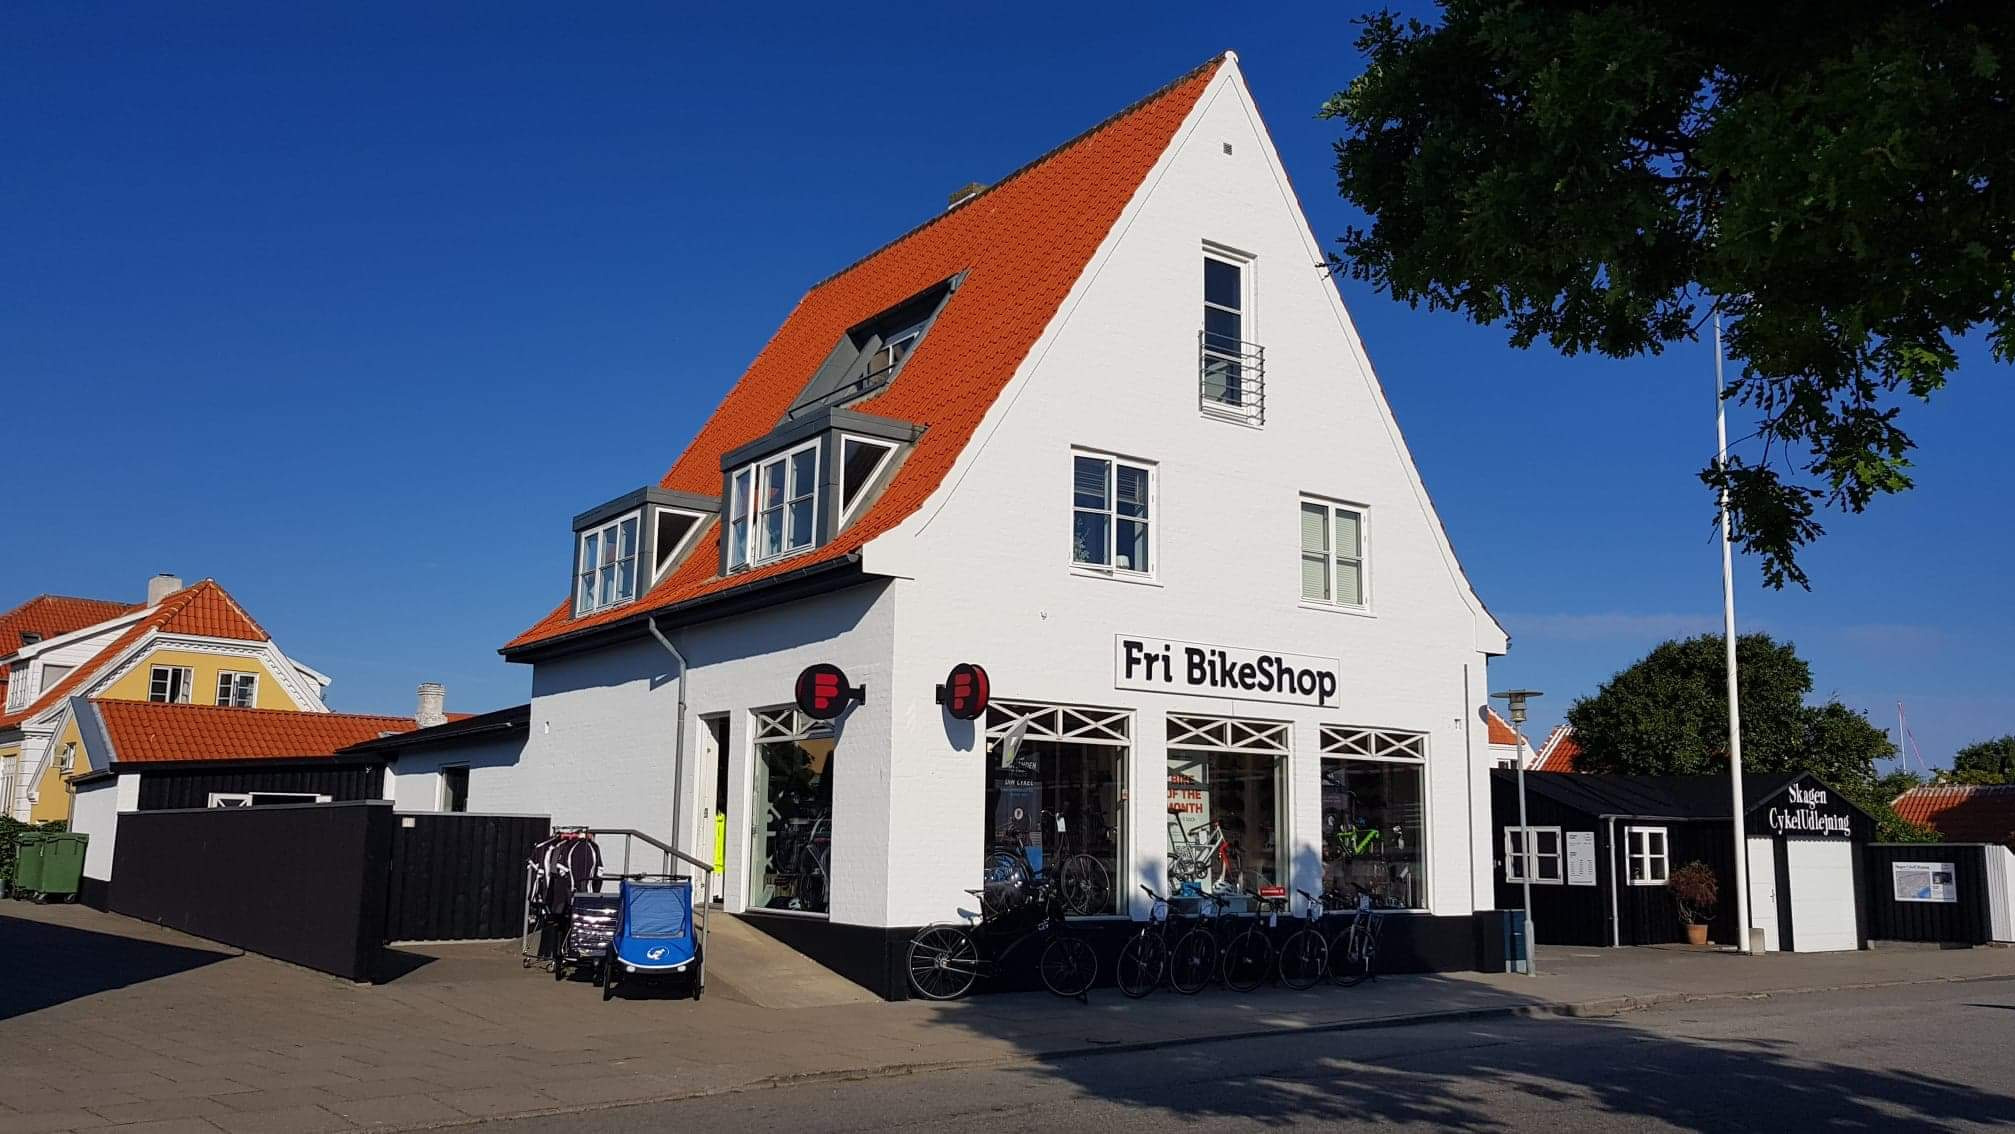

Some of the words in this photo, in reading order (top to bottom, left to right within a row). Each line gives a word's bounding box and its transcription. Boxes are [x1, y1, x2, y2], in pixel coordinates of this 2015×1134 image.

[1123, 639, 1173, 683] Fri
[1184, 646, 1337, 706] BikeShop
[1182, 789, 1202, 800] THE
[1788, 782, 1828, 810] Skagen
[1769, 806, 1851, 837] CykelUdlejning
